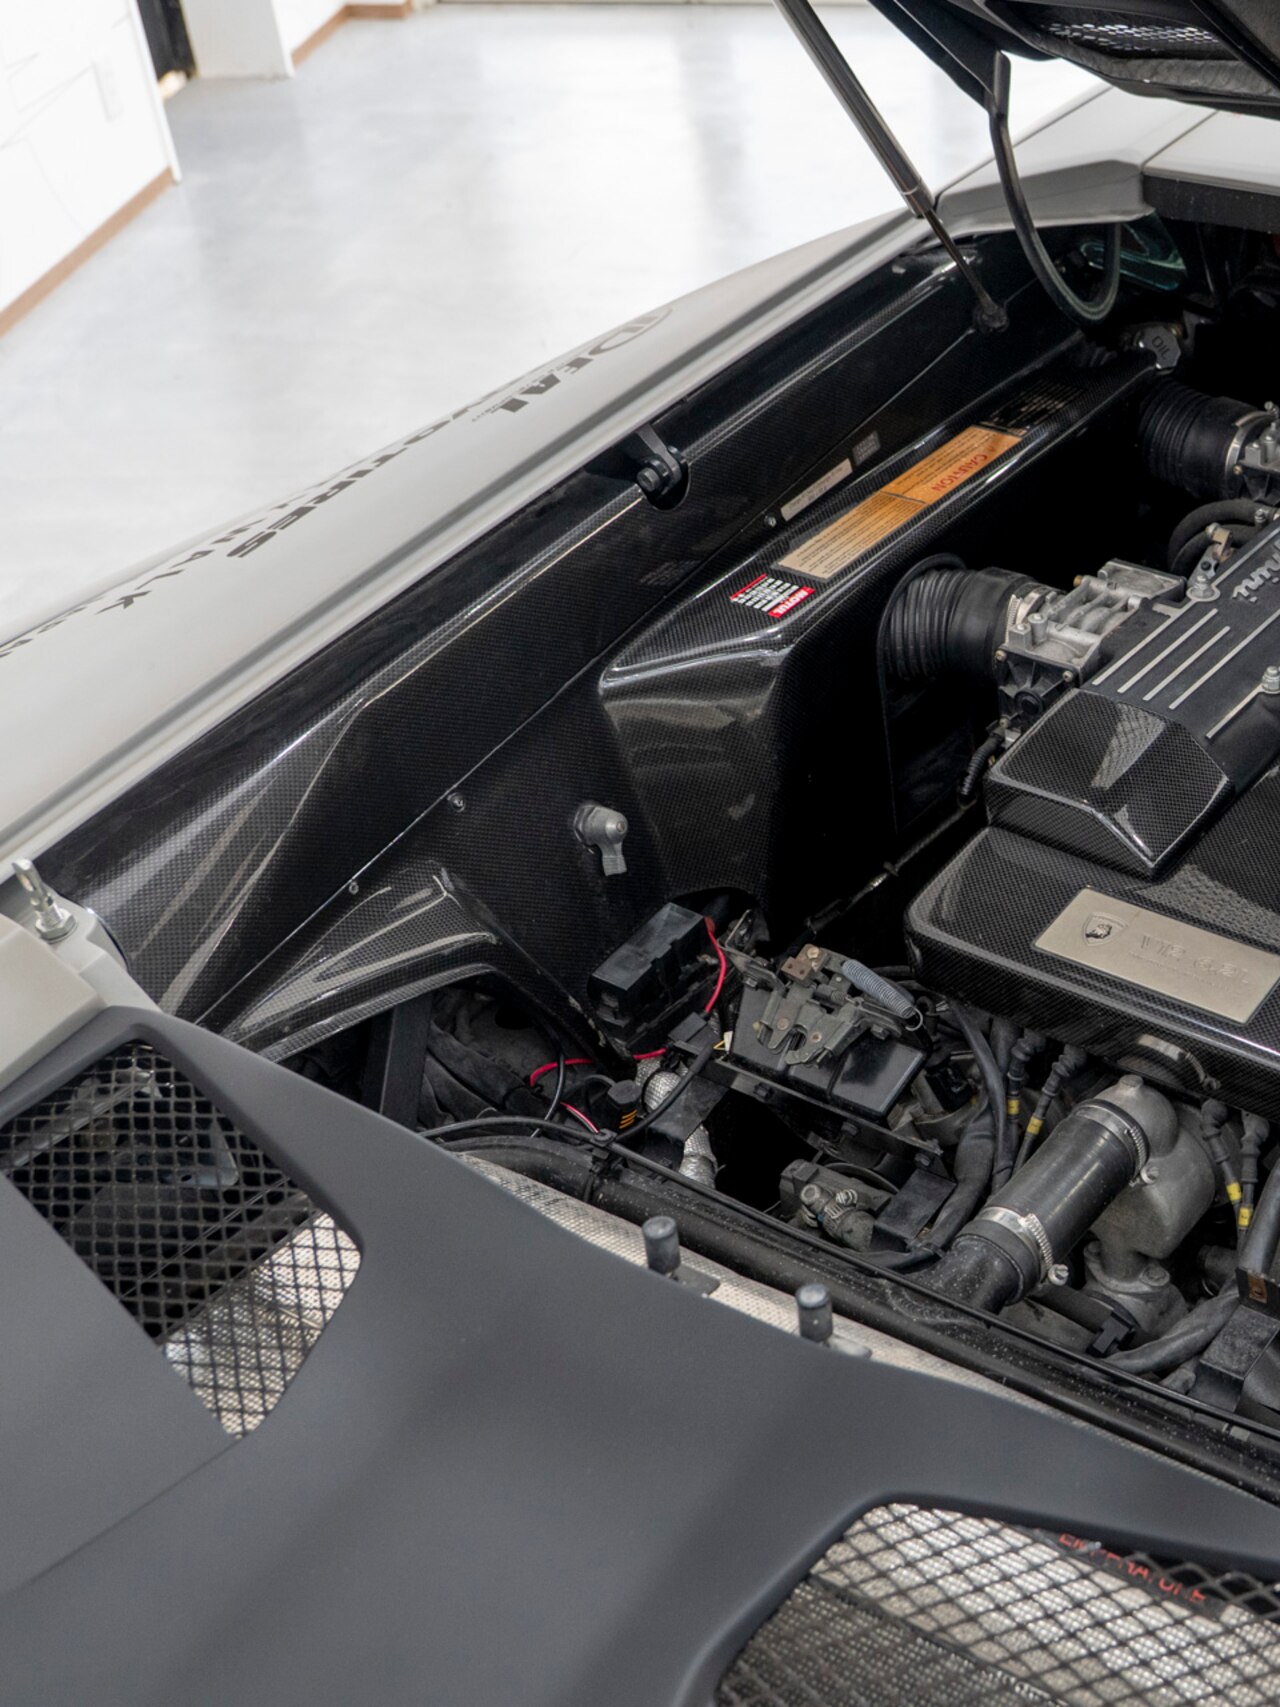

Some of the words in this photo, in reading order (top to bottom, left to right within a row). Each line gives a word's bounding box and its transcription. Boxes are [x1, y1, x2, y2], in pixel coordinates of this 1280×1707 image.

[1151, 335, 1170, 360] OIL
[931, 453, 988, 492] CAUTION
[772, 588, 809, 615] MOTUL
